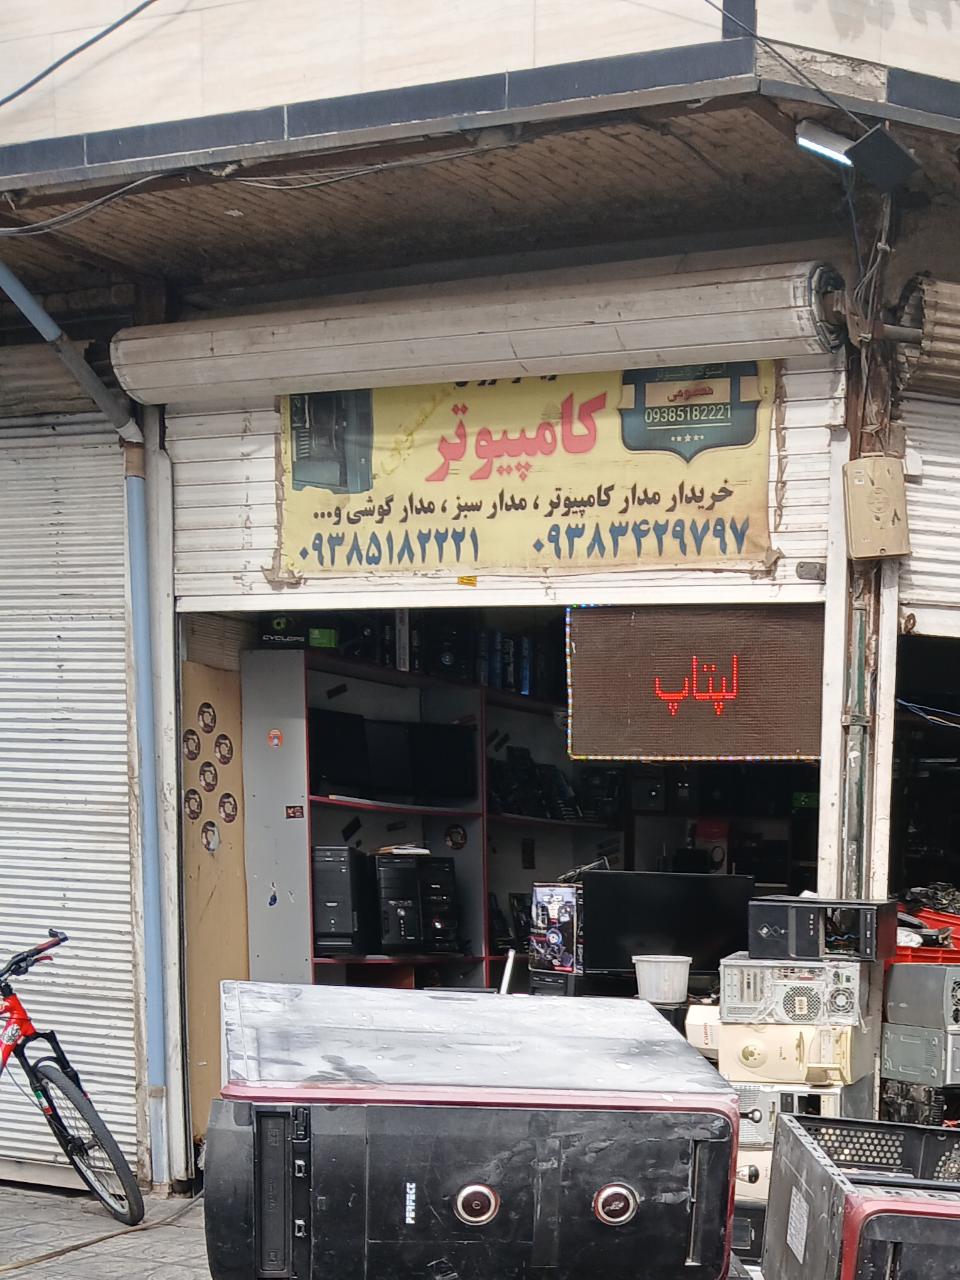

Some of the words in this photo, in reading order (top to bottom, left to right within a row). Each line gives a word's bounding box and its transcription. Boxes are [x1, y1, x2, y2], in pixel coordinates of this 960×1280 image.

[645, 405, 731, 423] 09385182221
[425, 390, 608, 482] کامپیوتر
[346, 494, 394, 525] گوشی
[400, 492, 435, 523] مدار
[451, 495, 483, 520] سبز
[486, 488, 527, 519] مدار
[544, 483, 615, 518] کامپیوتر
[618, 481, 661, 514] مدار
[666, 479, 734, 512] خریدار
[299, 527, 479, 567] ۰۹۳۸۵۱۸۲۲۲۱
[532, 515, 750, 560] ۰۹۳۸۳۴۲۹۷۹۷
[655, 654, 738, 716] لپتاپ
